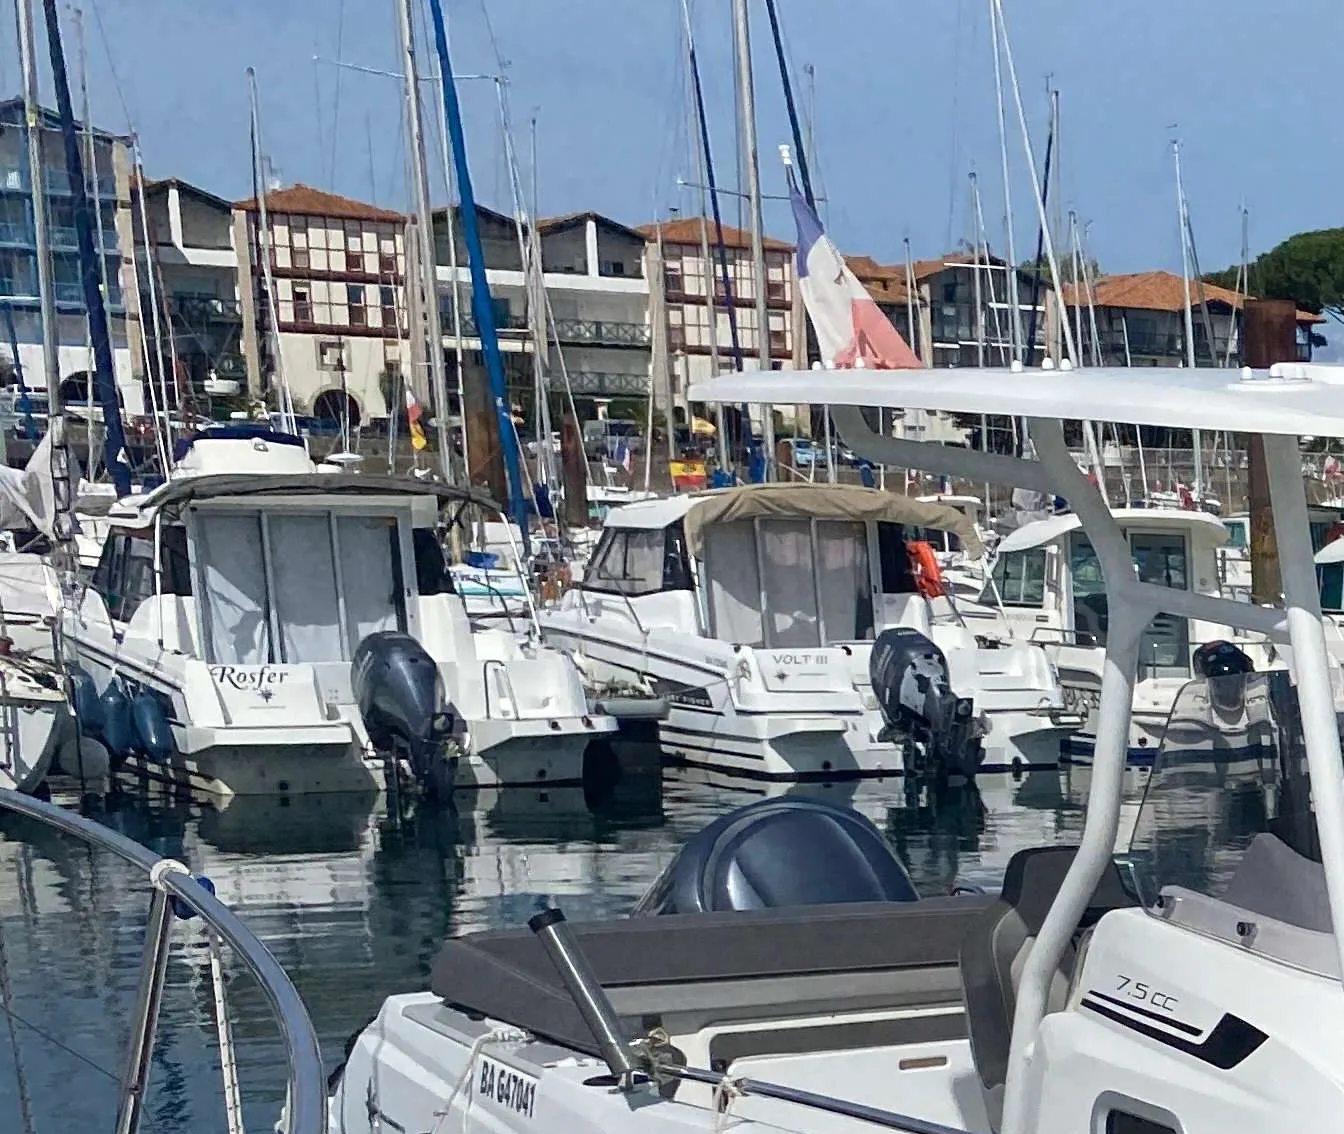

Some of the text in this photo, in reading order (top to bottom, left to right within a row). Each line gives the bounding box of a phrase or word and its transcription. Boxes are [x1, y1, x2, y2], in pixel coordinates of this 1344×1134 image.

[772, 654, 812, 665] VOLT
[210, 665, 288, 690] Rosfer
[1116, 974, 1179, 1013] 7.5 CC
[480, 1060, 495, 1099] BA
